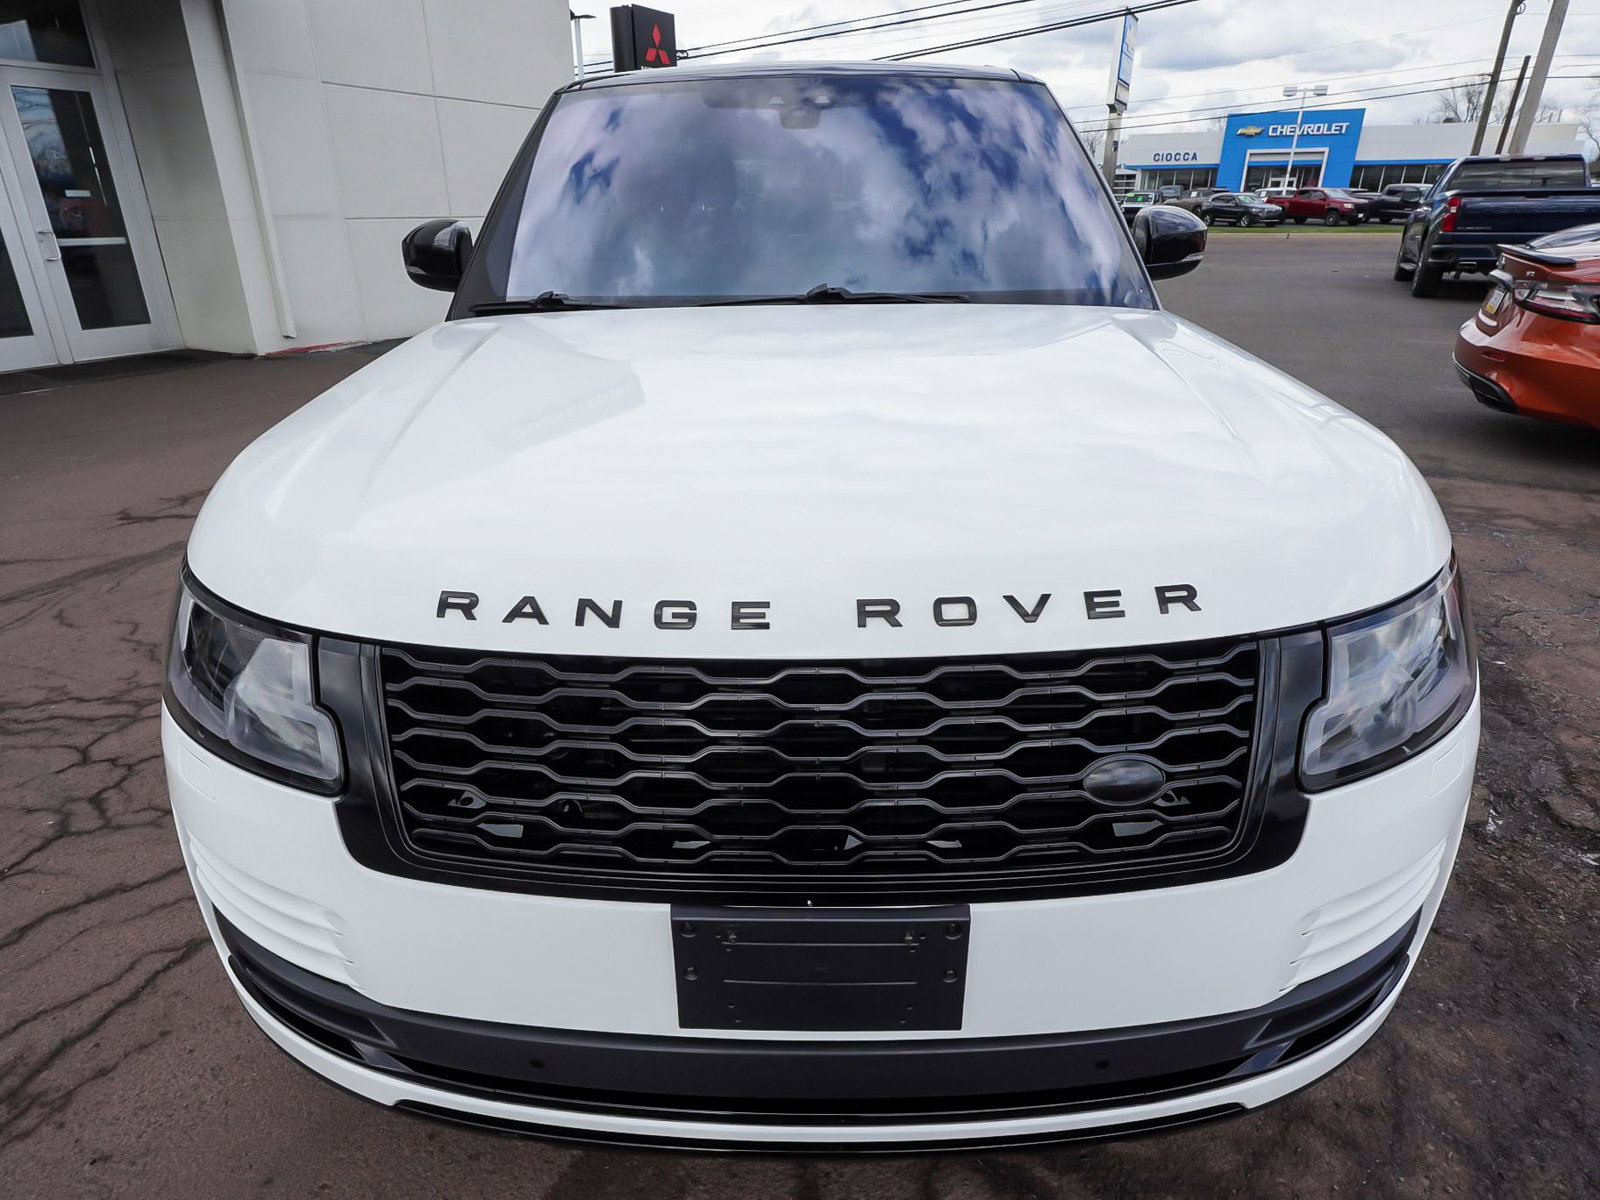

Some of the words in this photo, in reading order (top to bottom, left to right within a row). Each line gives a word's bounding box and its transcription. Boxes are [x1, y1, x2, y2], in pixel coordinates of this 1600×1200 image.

[1268, 122, 1350, 137] CHEVROLET
[1153, 152, 1198, 162] CIOCCA
[436, 590, 771, 631] RANGE
[856, 583, 1203, 628] ROVER
